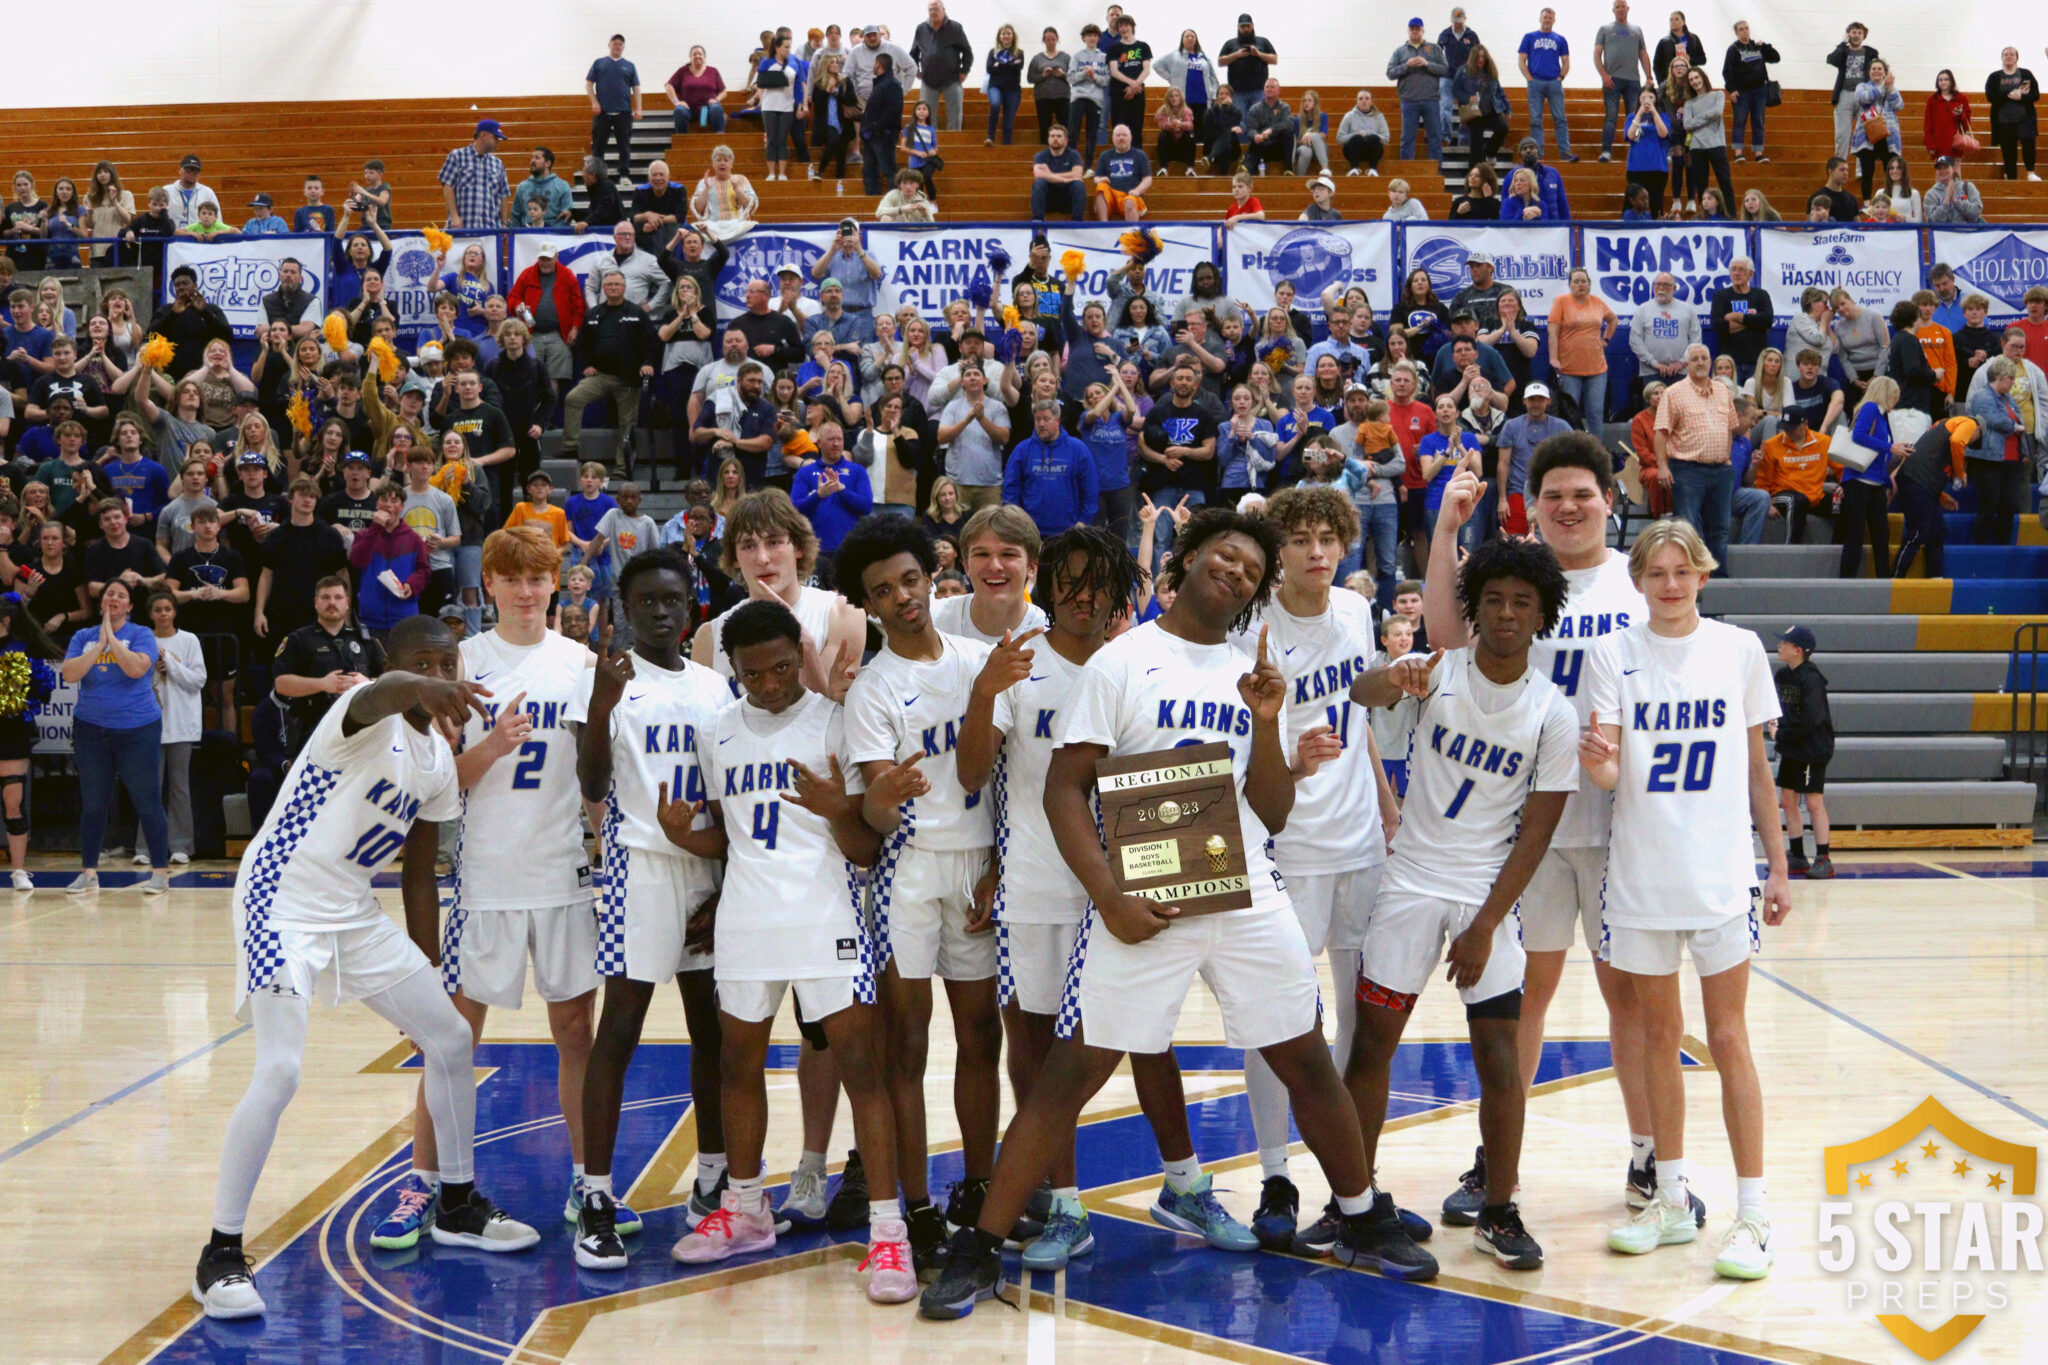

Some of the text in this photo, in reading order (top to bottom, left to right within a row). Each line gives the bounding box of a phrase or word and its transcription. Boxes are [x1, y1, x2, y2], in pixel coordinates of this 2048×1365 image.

[898, 238, 1003, 261] KARNS
[1596, 234, 1735, 273] HAM'N
[1781, 263, 1796, 271] THE
[1782, 270, 1902, 287] HASAN AGENCY
[1972, 258, 2048, 282] HOLSTO
[1600, 275, 1732, 305] GODYS
[1859, 297, 1885, 306] Agent
[1653, 317, 1679, 329] Blue
[1653, 328, 1679, 337] crew
[1295, 655, 1365, 706] KARNS
[1551, 649, 1585, 697] 4
[1157, 699, 1251, 737] KARNS
[1634, 698, 1727, 731] KARNS
[645, 724, 697, 754] KAR
[1431, 724, 1523, 778] KARNS
[512, 741, 548, 790] 2
[1114, 762, 1219, 788] REGIONAL
[1647, 740, 1717, 793] 20
[1444, 777, 1476, 819] 1
[752, 801, 780, 850] 4
[344, 823, 405, 868] 10
[1128, 842, 1162, 854] DIVISION
[1140, 853, 1160, 861] BOYS
[1129, 858, 1174, 870] BASKETBALL
[1134, 877, 1244, 901] HAMPIONS
